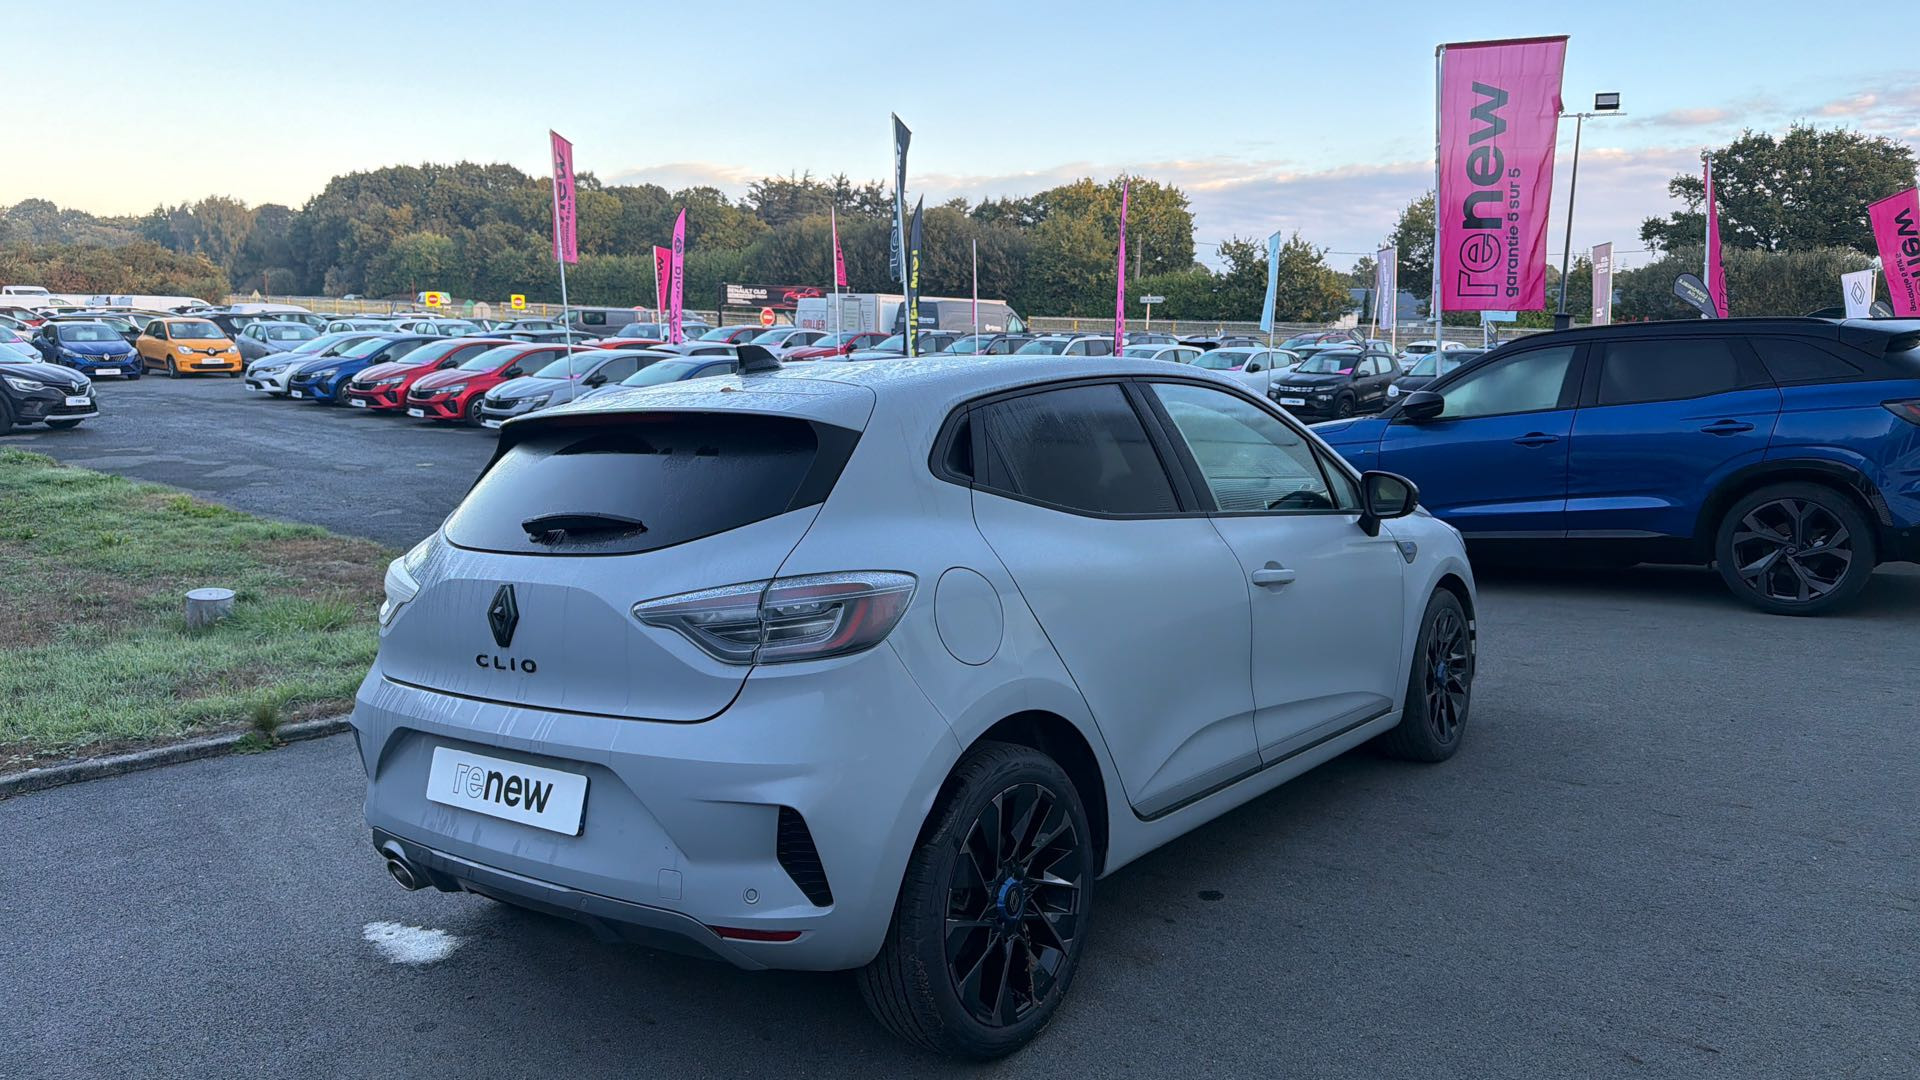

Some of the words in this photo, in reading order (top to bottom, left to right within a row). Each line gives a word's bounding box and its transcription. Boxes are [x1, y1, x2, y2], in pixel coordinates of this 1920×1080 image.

[1508, 167, 1521, 178] 5
[1457, 80, 1509, 297] renew
[1509, 183, 1521, 210] sur
[1507, 212, 1520, 223] 5
[1505, 226, 1521, 298] garantie
[475, 654, 538, 674] CLIO
[452, 762, 554, 814] renew
